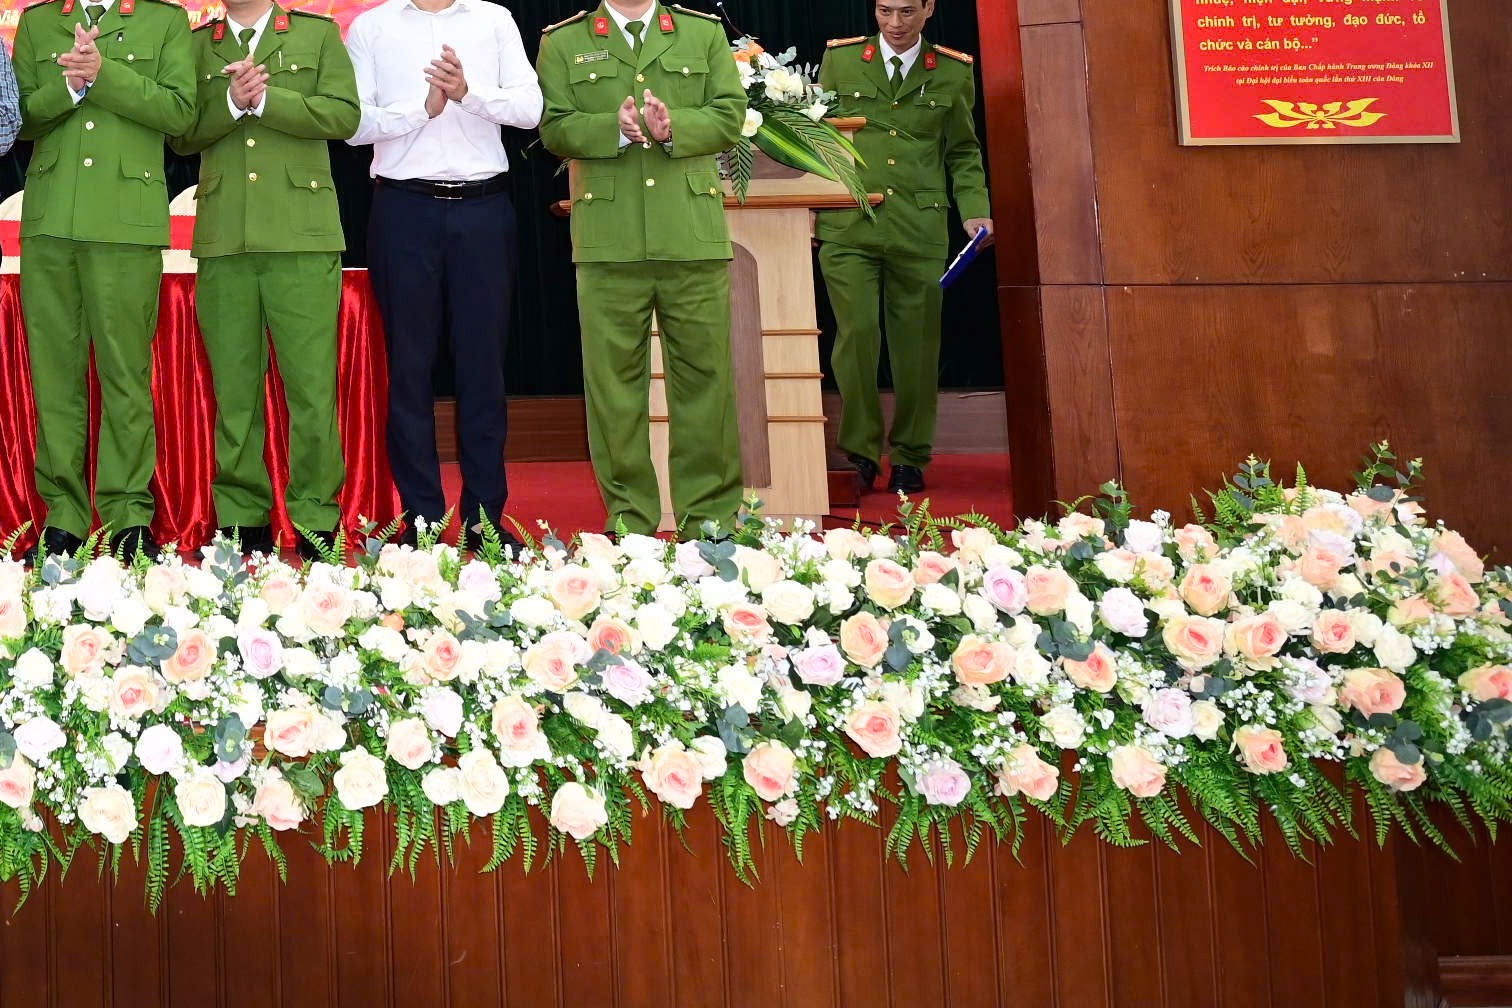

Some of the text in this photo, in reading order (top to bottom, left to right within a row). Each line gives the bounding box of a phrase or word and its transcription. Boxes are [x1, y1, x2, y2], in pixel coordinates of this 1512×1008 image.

[1198, 10, 1425, 29] chính trị, tư tưởng, đạo đức, tổ
[1200, 39, 1233, 50] chức
[1237, 38, 1252, 49] và
[1256, 38, 1280, 49] cán
